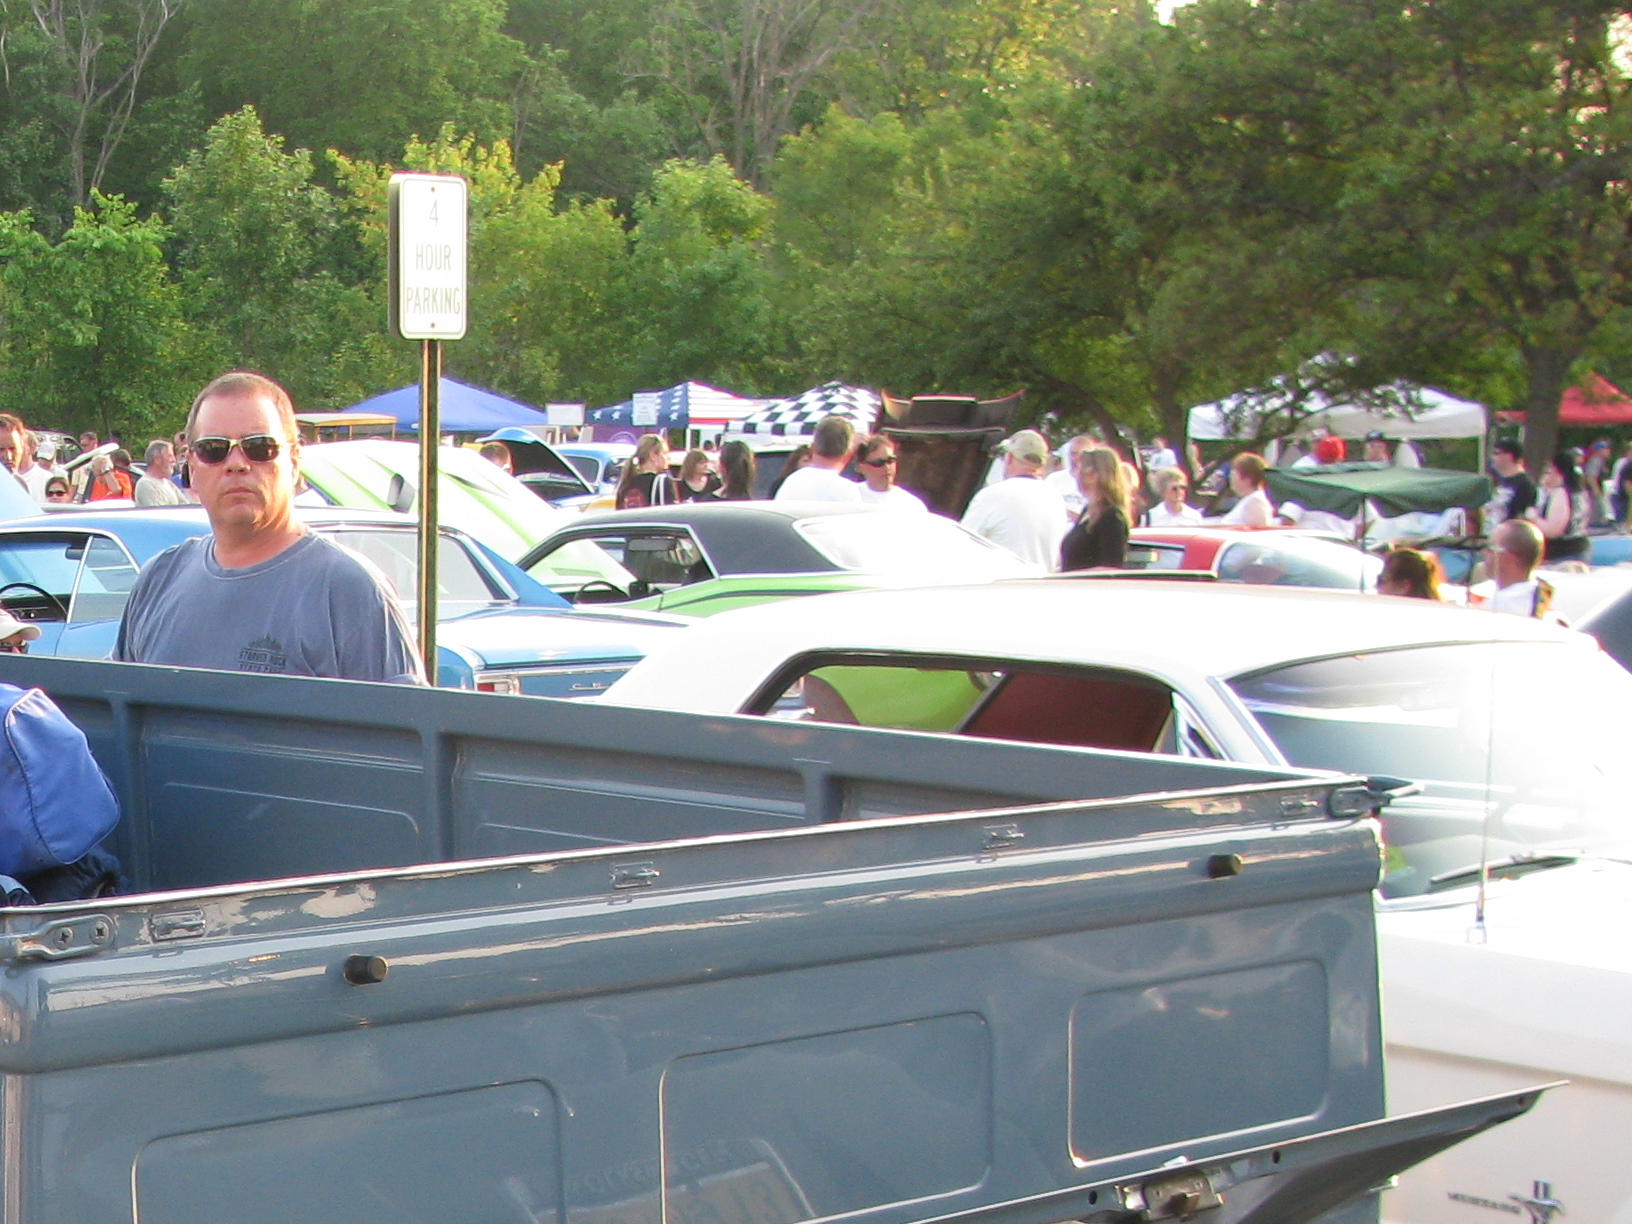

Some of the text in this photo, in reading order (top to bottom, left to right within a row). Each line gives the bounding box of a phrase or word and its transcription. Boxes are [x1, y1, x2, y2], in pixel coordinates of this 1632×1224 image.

[429, 199, 439, 226] 4
[416, 243, 451, 271] HOUR
[406, 287, 461, 315] PARKING
